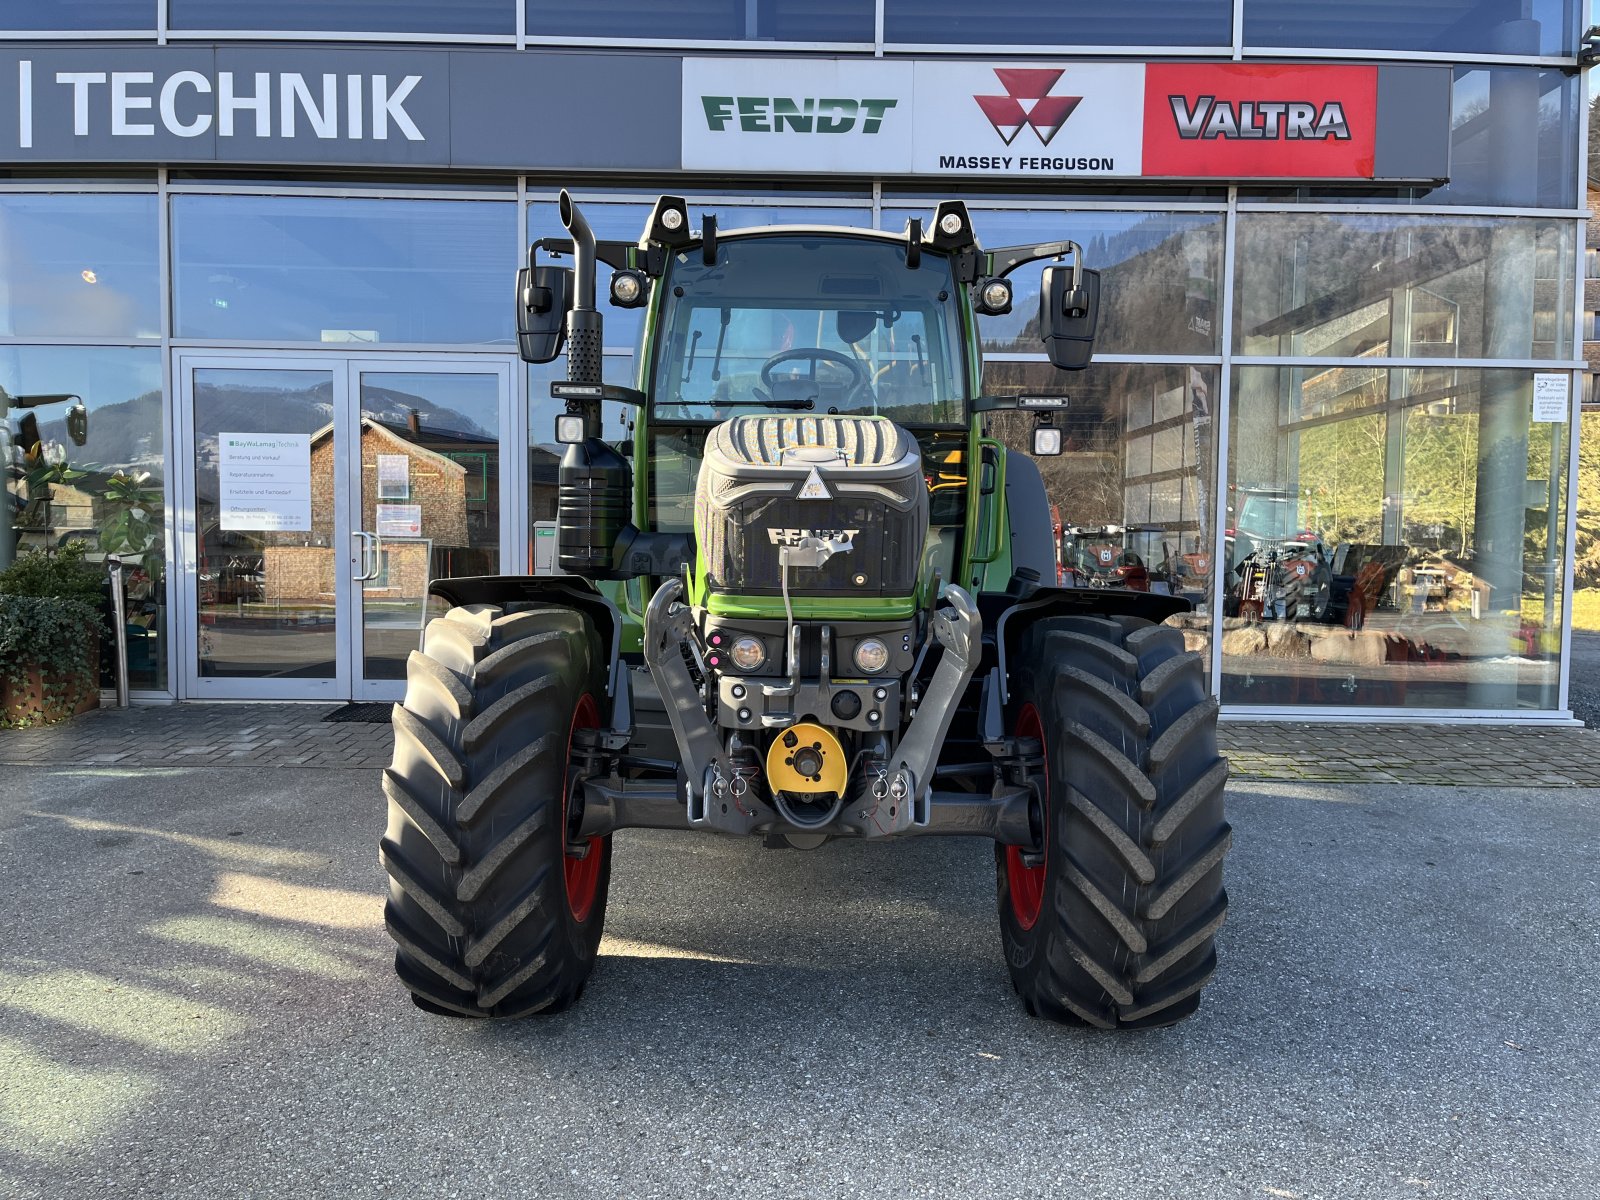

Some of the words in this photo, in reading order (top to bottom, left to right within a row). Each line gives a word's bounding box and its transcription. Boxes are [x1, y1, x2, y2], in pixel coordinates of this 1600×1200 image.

[56, 71, 426, 141] TECHNIK
[700, 95, 898, 134] FENDT
[939, 155, 1012, 170] MASSEY
[1019, 156, 1114, 171] FERGUSON
